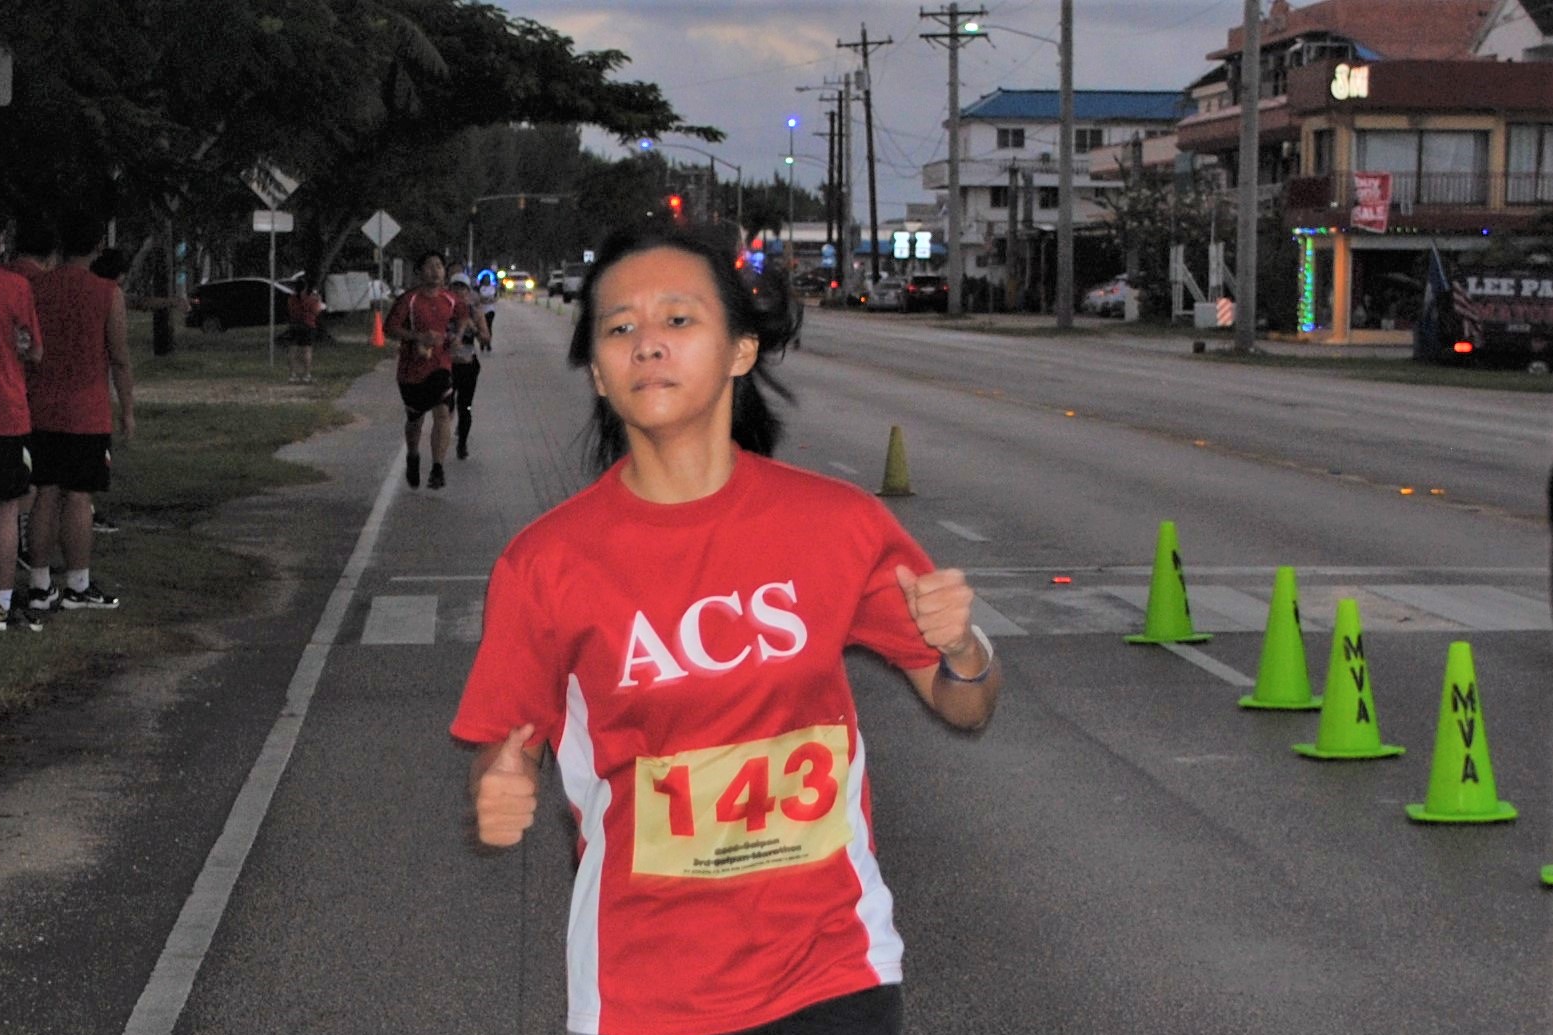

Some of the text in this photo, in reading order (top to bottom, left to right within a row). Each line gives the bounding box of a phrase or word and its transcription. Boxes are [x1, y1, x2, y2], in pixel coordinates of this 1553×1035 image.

[1467, 277, 1515, 296] LEE
[617, 579, 808, 688] ACS
[1344, 634, 1370, 724] MVA
[1452, 682, 1480, 783] MVA
[653, 741, 839, 837] 143
